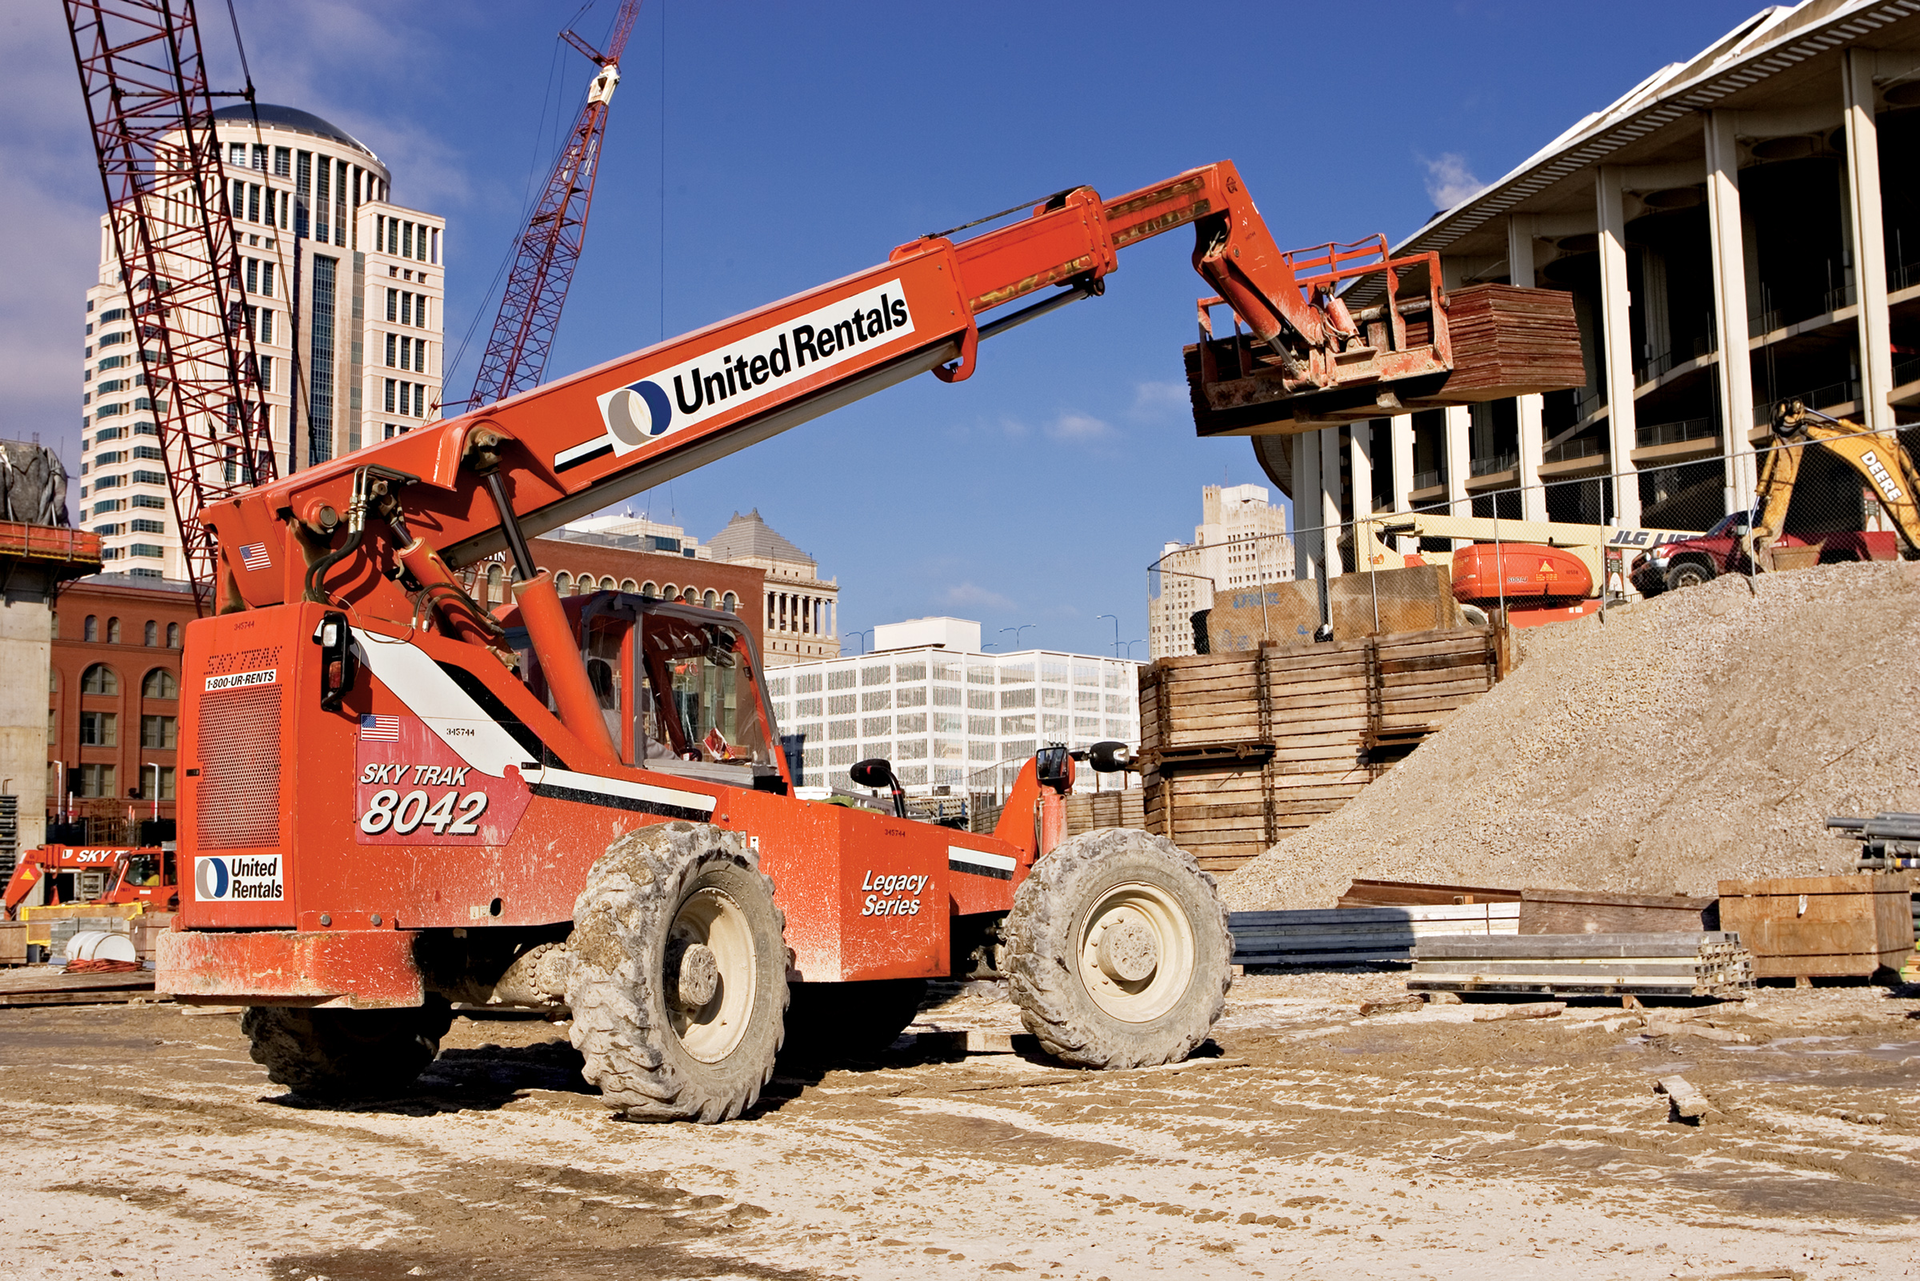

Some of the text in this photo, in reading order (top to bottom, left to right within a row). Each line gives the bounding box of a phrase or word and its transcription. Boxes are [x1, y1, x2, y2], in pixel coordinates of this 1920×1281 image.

[673, 293, 908, 415] United Rentals
[1860, 449, 1903, 502] DEERE
[1609, 530, 1650, 545] JLG
[446, 728, 475, 737] 345744
[360, 763, 473, 786] SKY TRAK
[360, 789, 488, 836] 8042
[884, 828, 906, 838] 345744
[76, 849, 112, 863] SKY
[231, 857, 277, 878] United
[231, 879, 283, 899] Rentals
[861, 870, 929, 896] Legacy
[861, 894, 921, 917] Series
